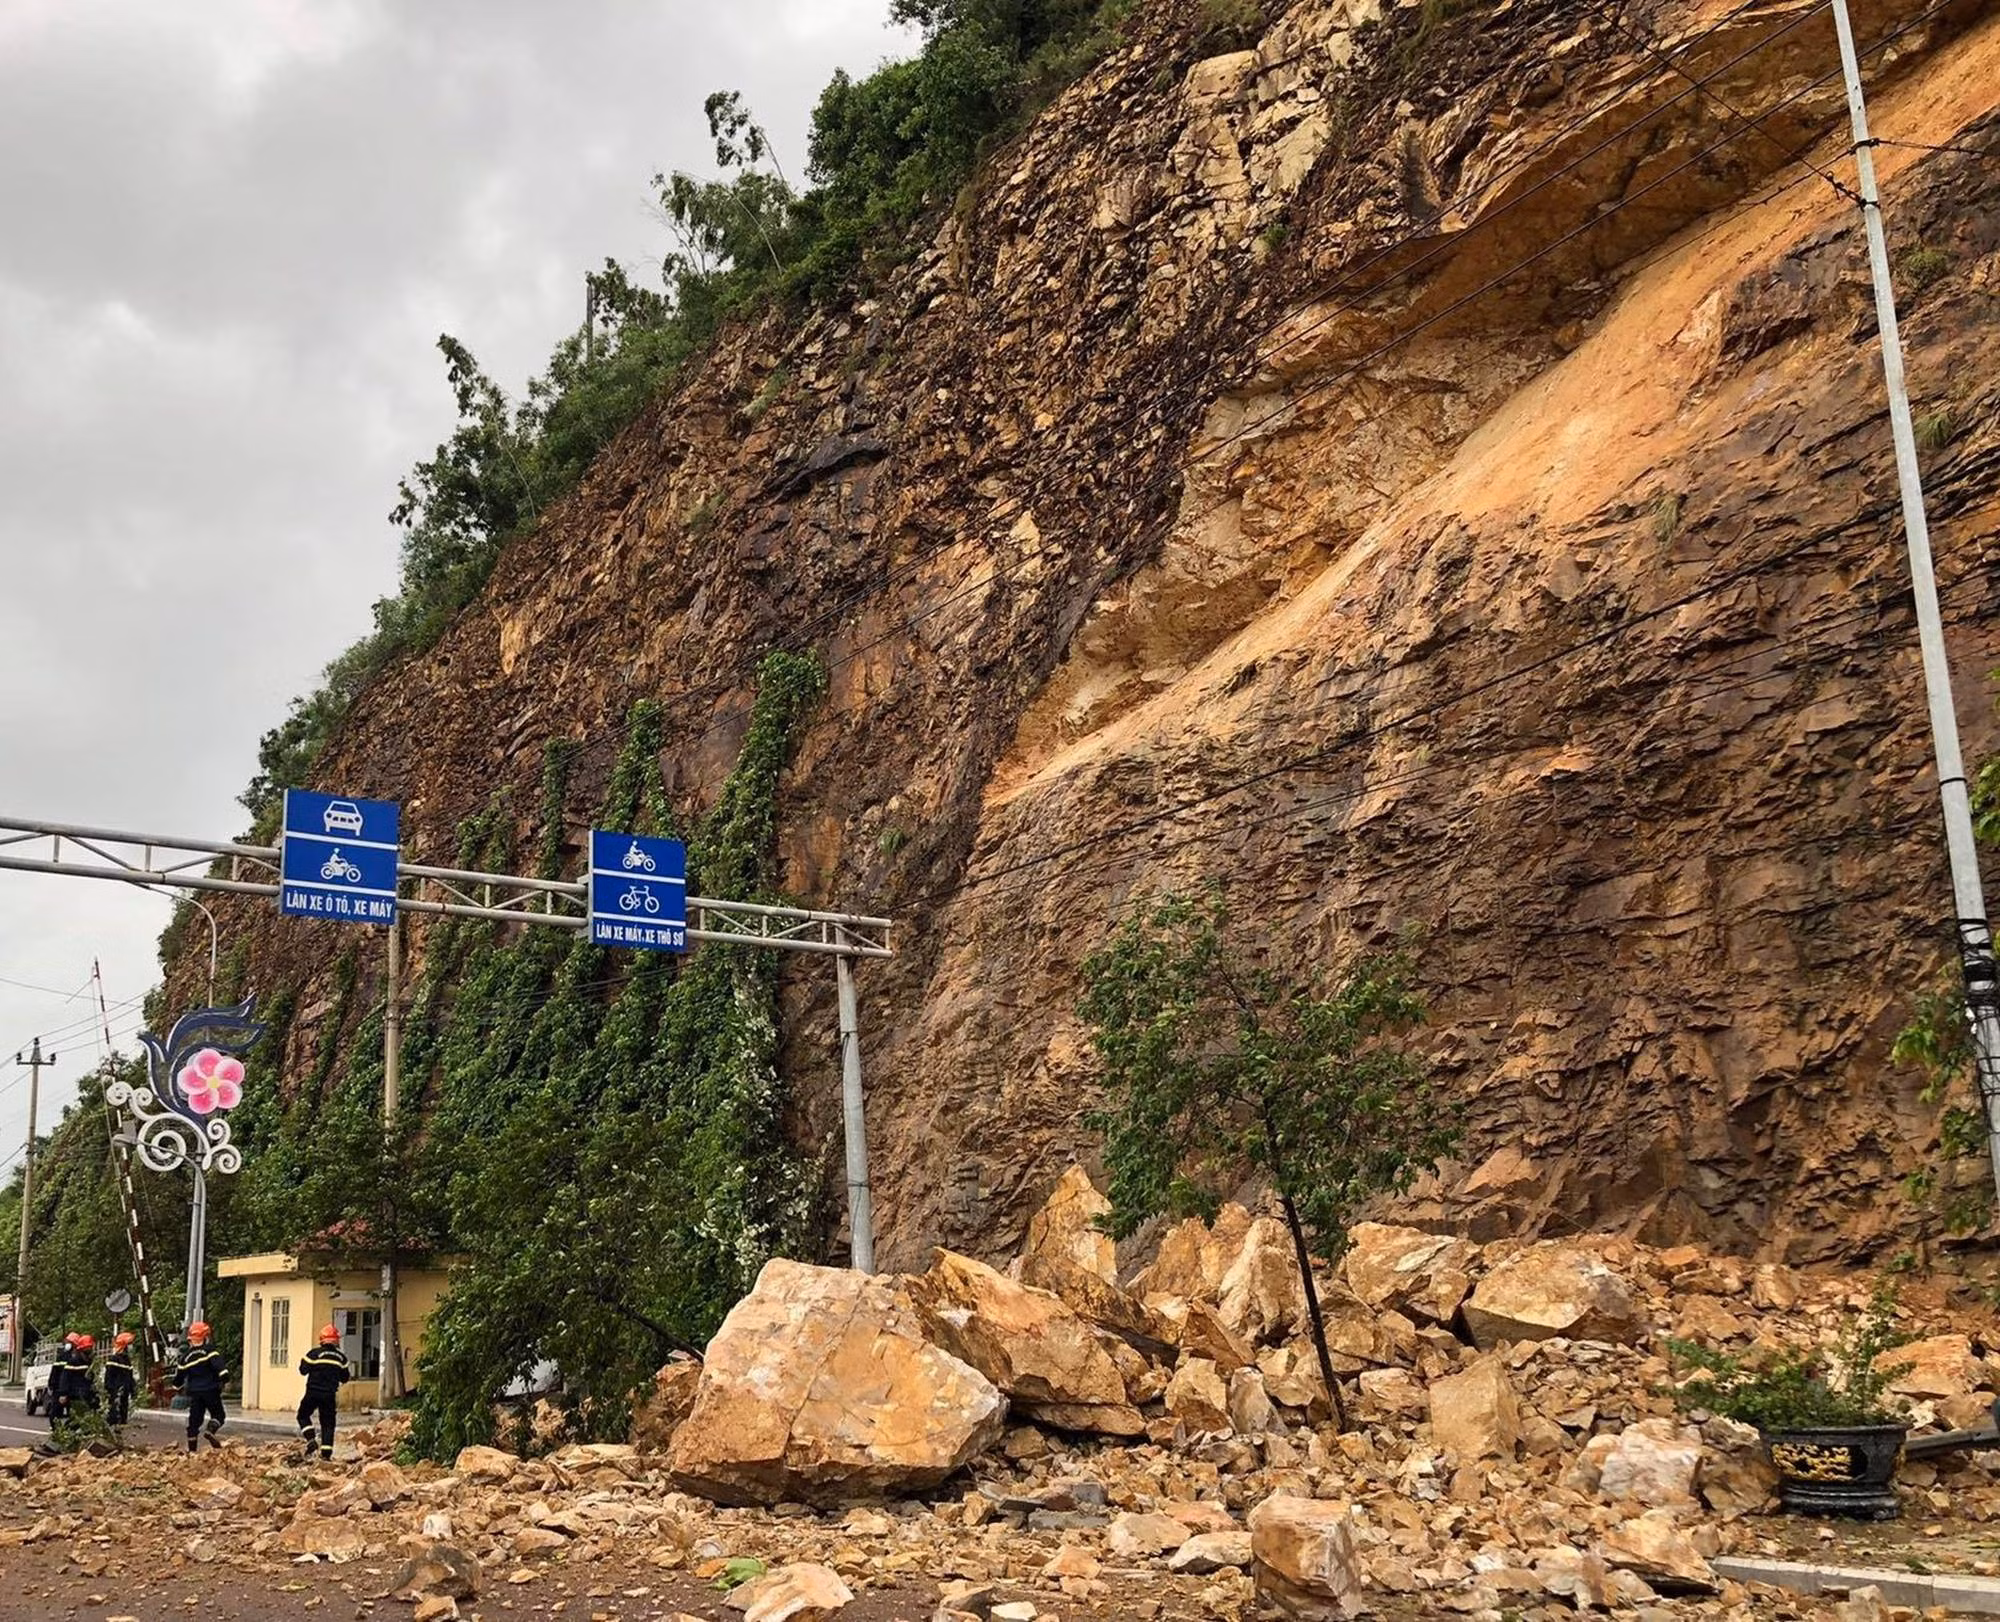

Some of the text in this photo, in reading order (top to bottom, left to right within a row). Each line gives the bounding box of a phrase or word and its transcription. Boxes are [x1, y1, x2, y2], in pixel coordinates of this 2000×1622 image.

[286, 890, 307, 909] LÀN
[309, 894, 323, 911] XE
[353, 900, 367, 915] XE
[369, 899, 393, 918] MÁY
[596, 921, 612, 938] LÀN
[613, 925, 624, 940] XE
